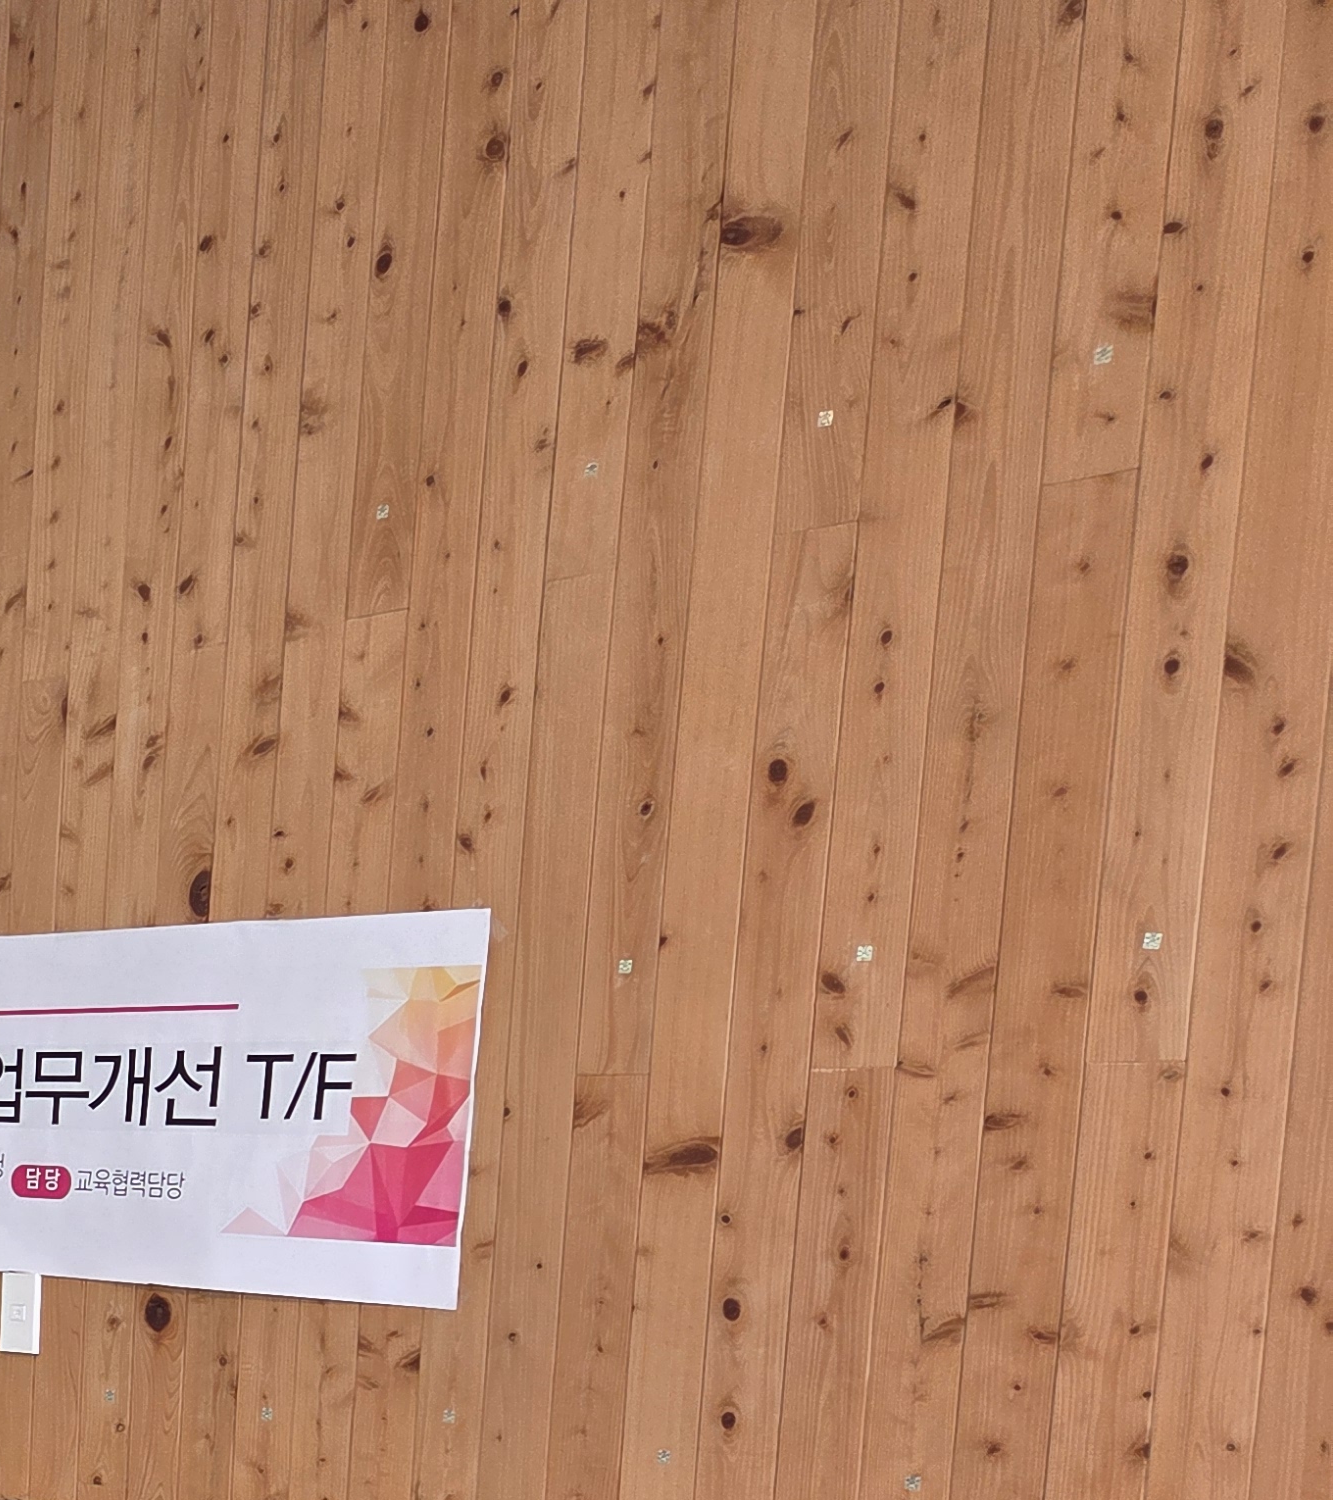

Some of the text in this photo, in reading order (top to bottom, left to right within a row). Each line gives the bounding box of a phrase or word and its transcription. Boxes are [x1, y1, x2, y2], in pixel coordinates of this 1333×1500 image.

[246, 1050, 358, 1121] T/F
[25, 1167, 186, 1200] 담당 교육협력담당
